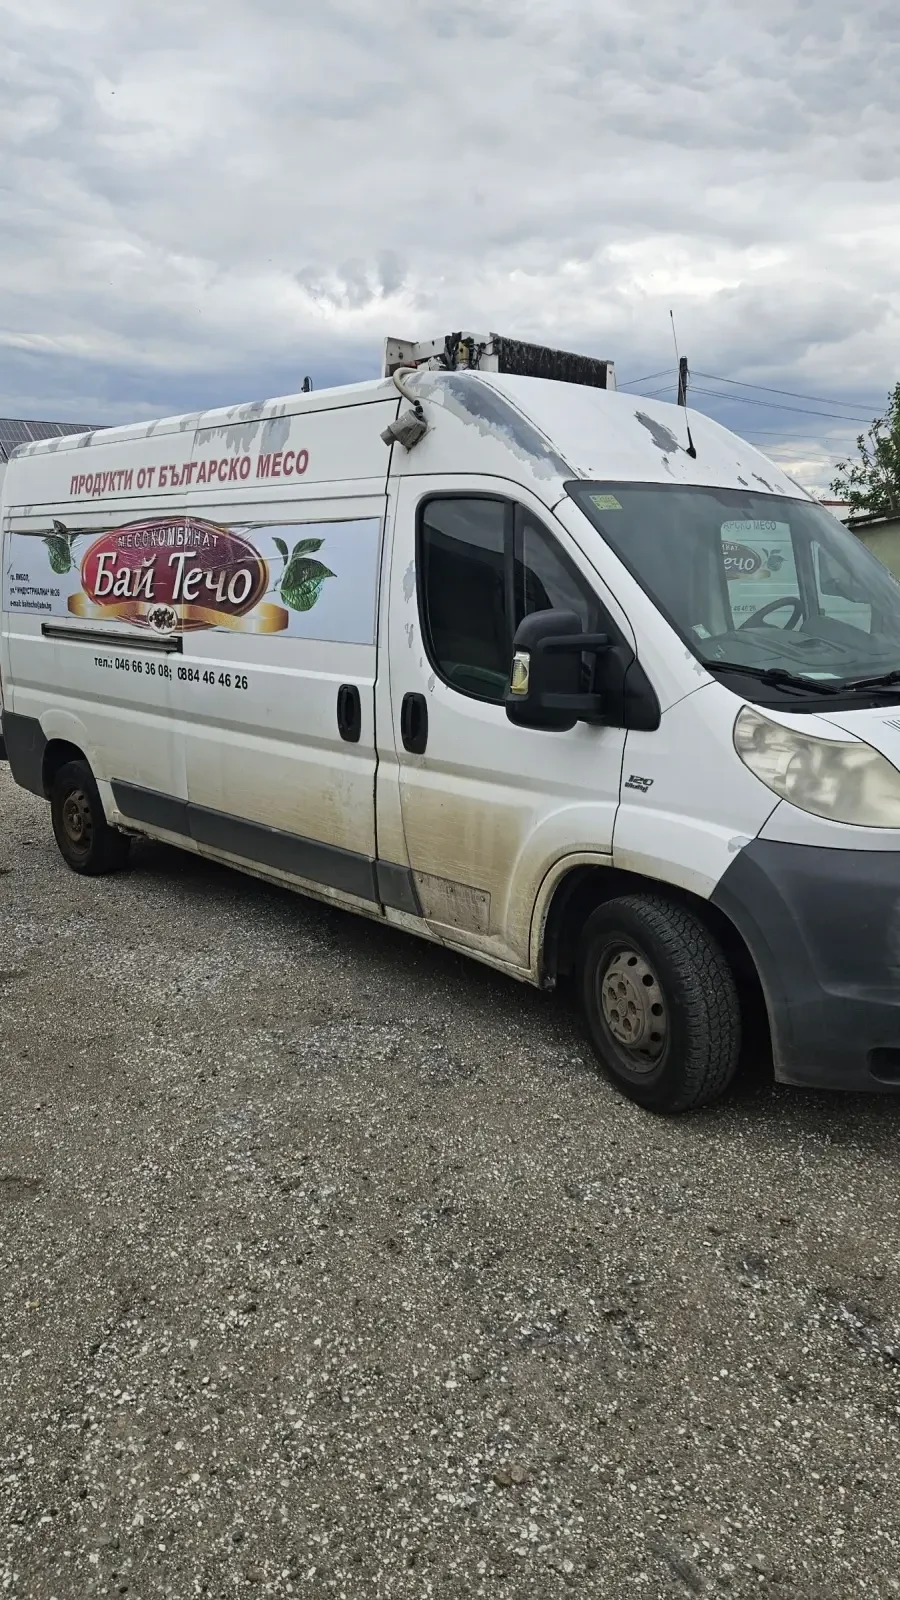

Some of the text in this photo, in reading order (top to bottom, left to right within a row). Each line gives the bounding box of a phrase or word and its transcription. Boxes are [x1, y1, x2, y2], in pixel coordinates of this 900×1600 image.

[70, 448, 309, 497] ПРОДУКТИ ОТ БЪЛГАРСКО МЕСО
[117, 526, 219, 548] МЕСОКОМБИНАТ
[94, 551, 252, 604] Бай Течо
[722, 552, 755, 570] ечо
[94, 657, 113, 669] тел.:
[114, 657, 130, 672] 046
[132, 660, 143, 674] 66
[145, 662, 156, 676] 36
[177, 667, 200, 683] 0884
[202, 670, 215, 685] 46
[218, 673, 231, 688] 46
[234, 675, 249, 690] 26
